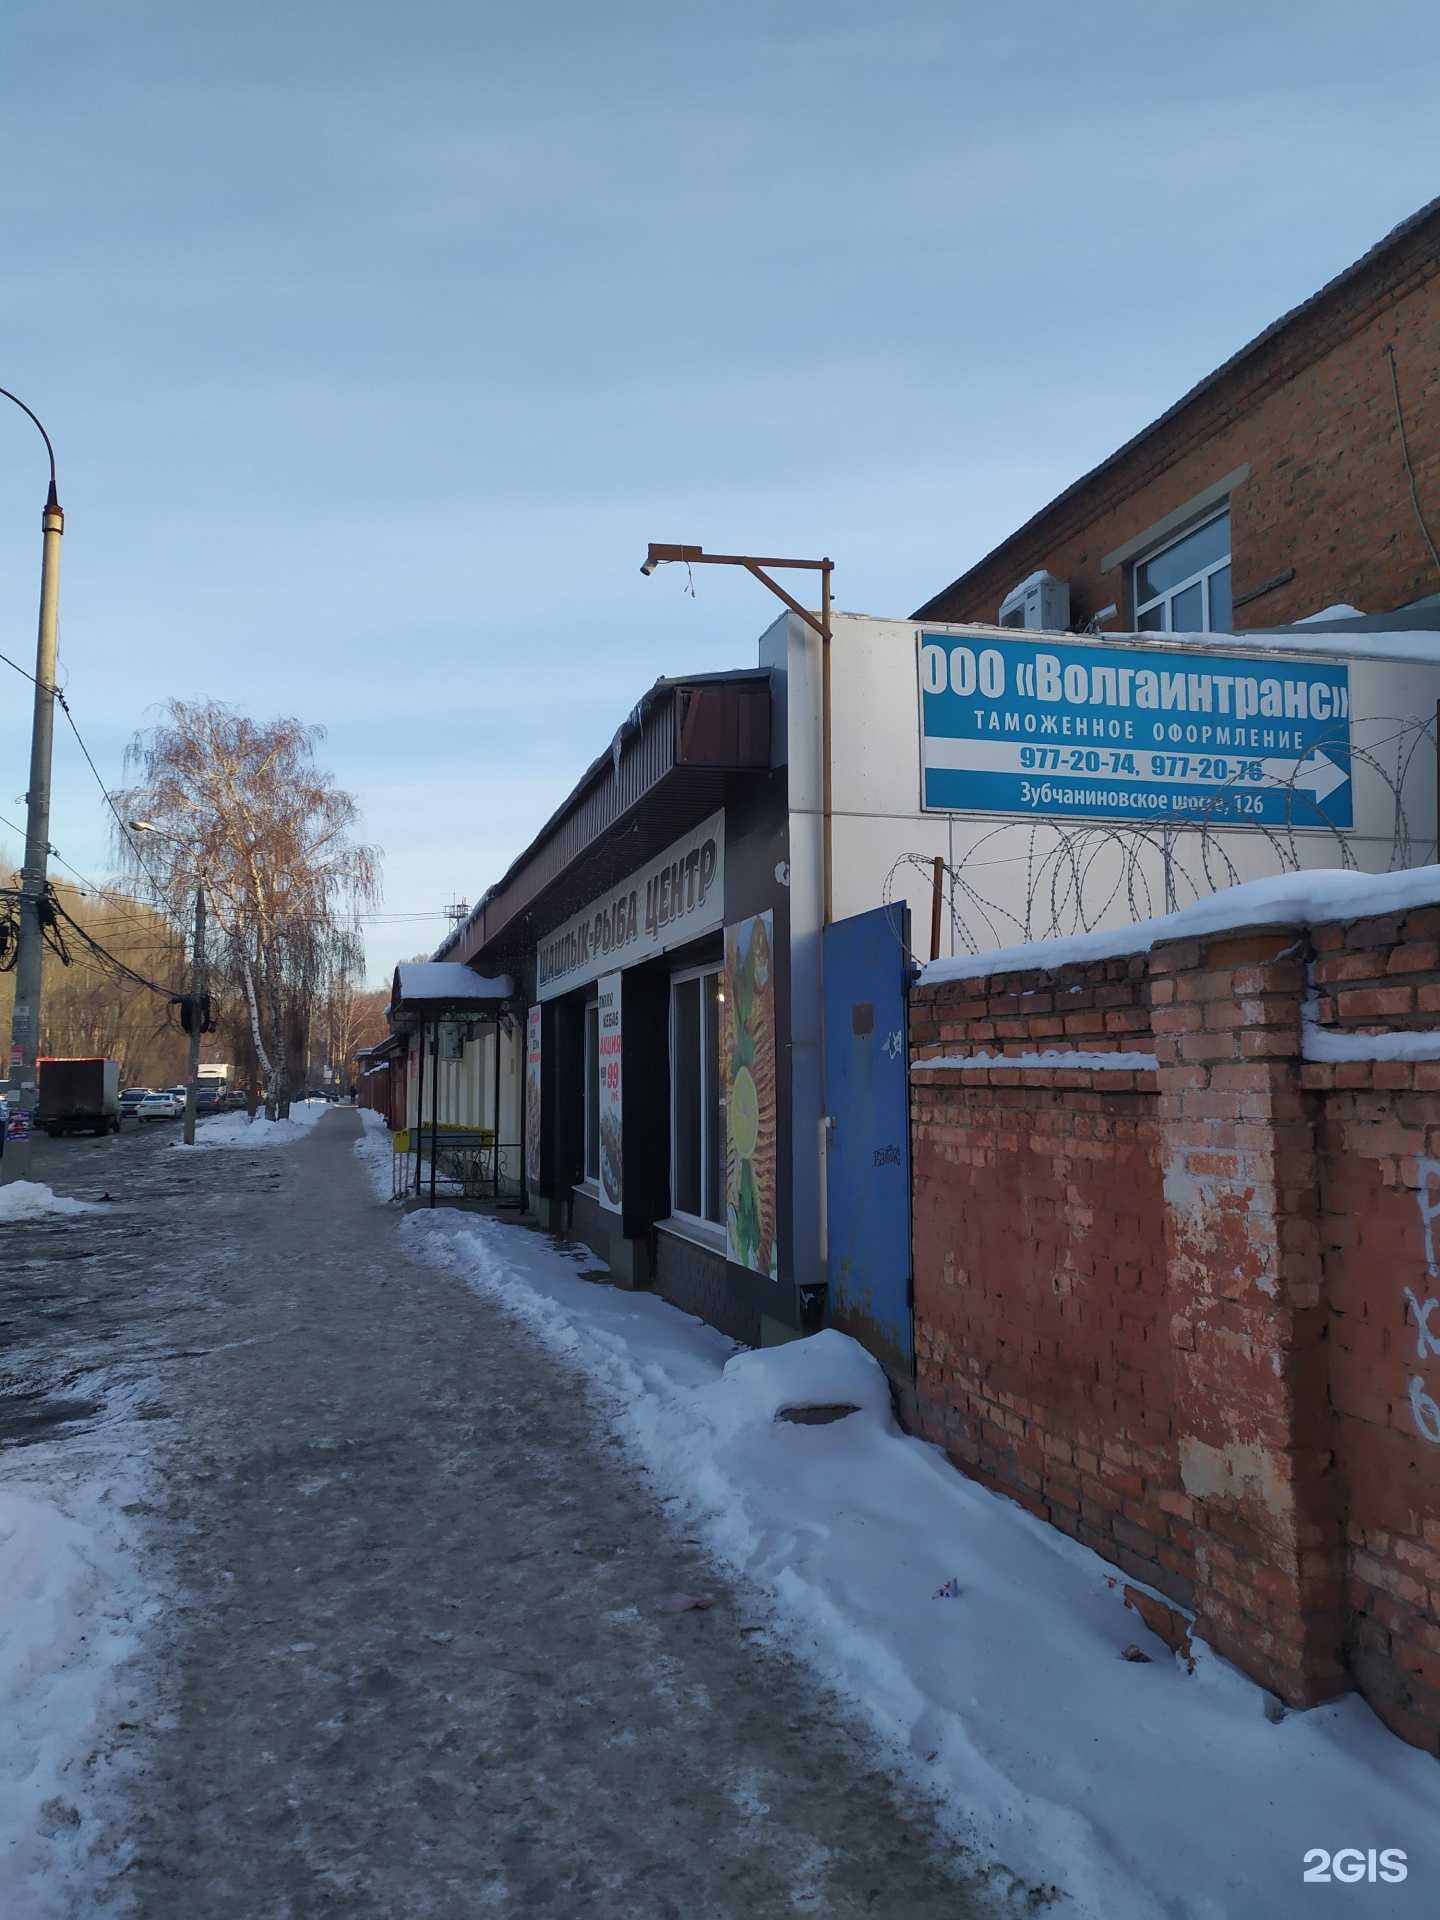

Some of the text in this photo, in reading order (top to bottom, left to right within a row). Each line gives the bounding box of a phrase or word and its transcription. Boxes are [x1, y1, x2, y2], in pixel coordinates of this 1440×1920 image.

[920, 644, 1349, 720] ООО «Волгаинтранс»
[974, 710, 1304, 750] ТАМОЖЕННОЕ ОФОРМЛЕНИЕ
[1020, 746, 1140, 777] 977-20-74,
[1020, 781, 1168, 808] Зубчаниновское
[1233, 794, 1264, 813] 126
[645, 838, 718, 941] ЦЕНТР
